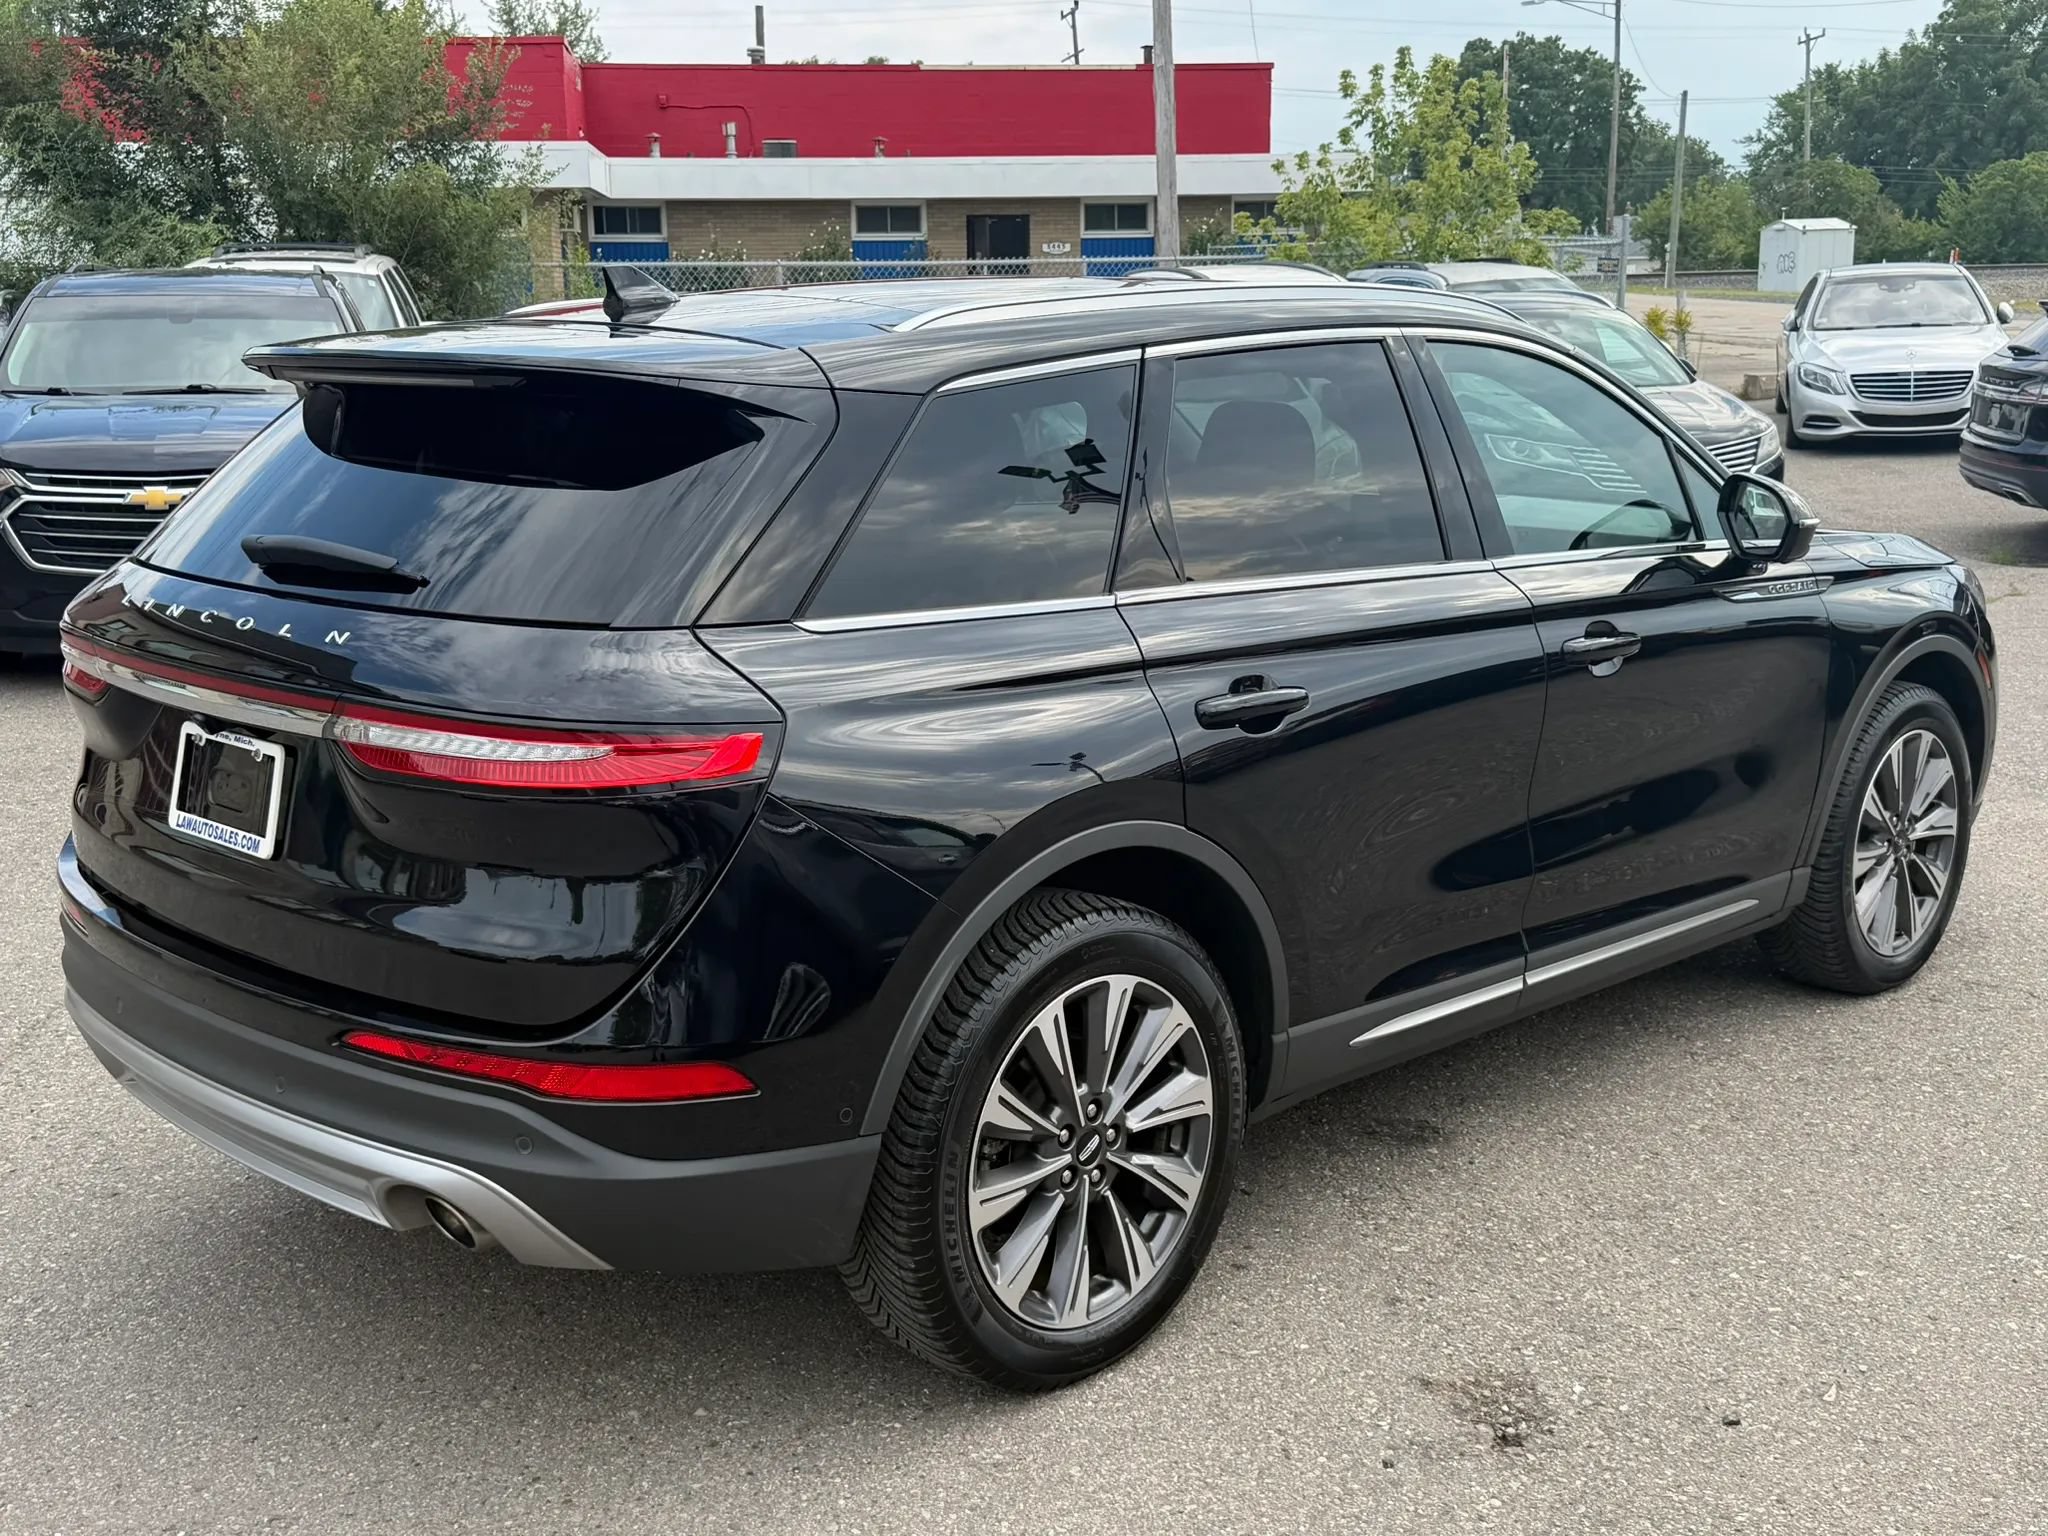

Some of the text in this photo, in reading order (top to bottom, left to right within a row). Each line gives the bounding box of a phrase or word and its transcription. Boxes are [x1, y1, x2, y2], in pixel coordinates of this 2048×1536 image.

[121, 593, 350, 645] LINCOLN
[234, 736, 255, 747] Mich.
[176, 814, 261, 853] LAWAUTOSALES.COM
[943, 1151, 966, 1284] MICHELIN
